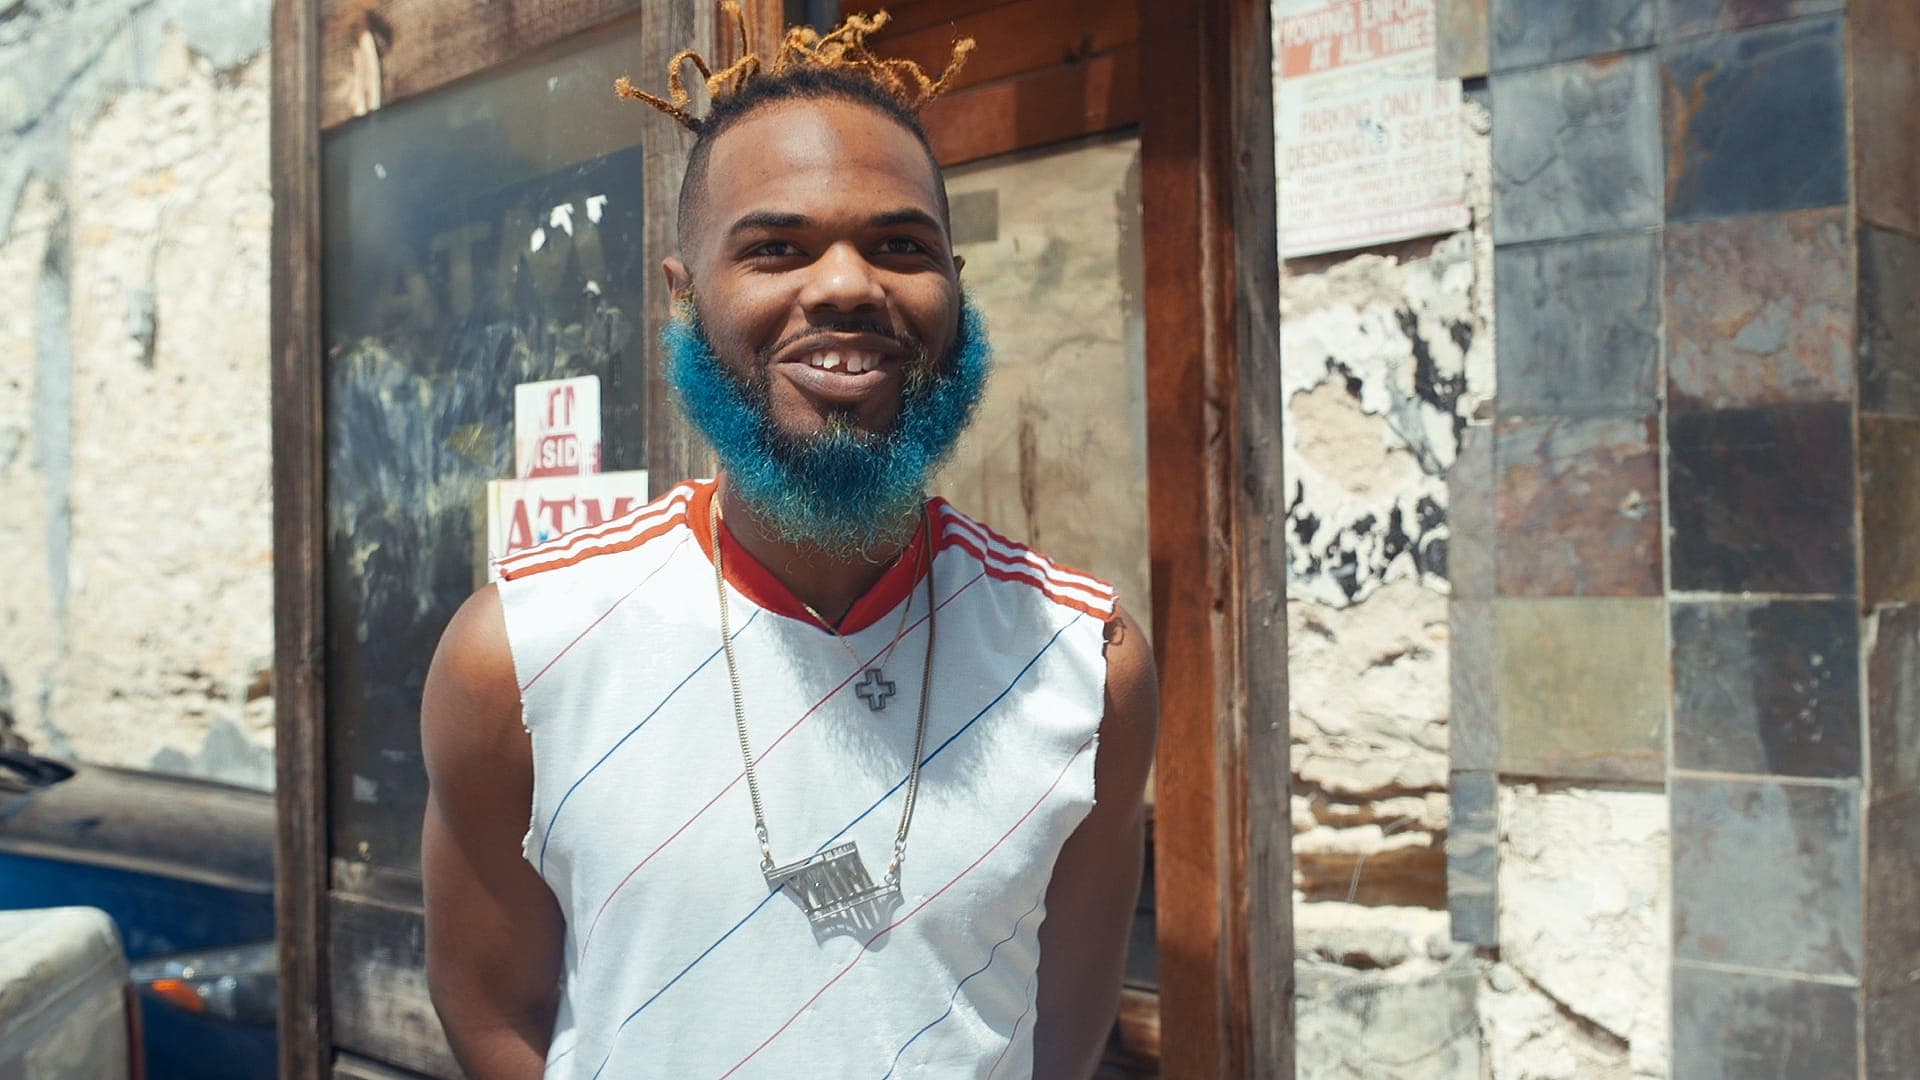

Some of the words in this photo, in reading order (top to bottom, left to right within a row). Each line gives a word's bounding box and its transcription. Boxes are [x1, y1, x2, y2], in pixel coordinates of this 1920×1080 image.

[1380, 87, 1425, 117] ONLY
[1432, 84, 1451, 108] IN
[1400, 112, 1455, 149] SPACE
